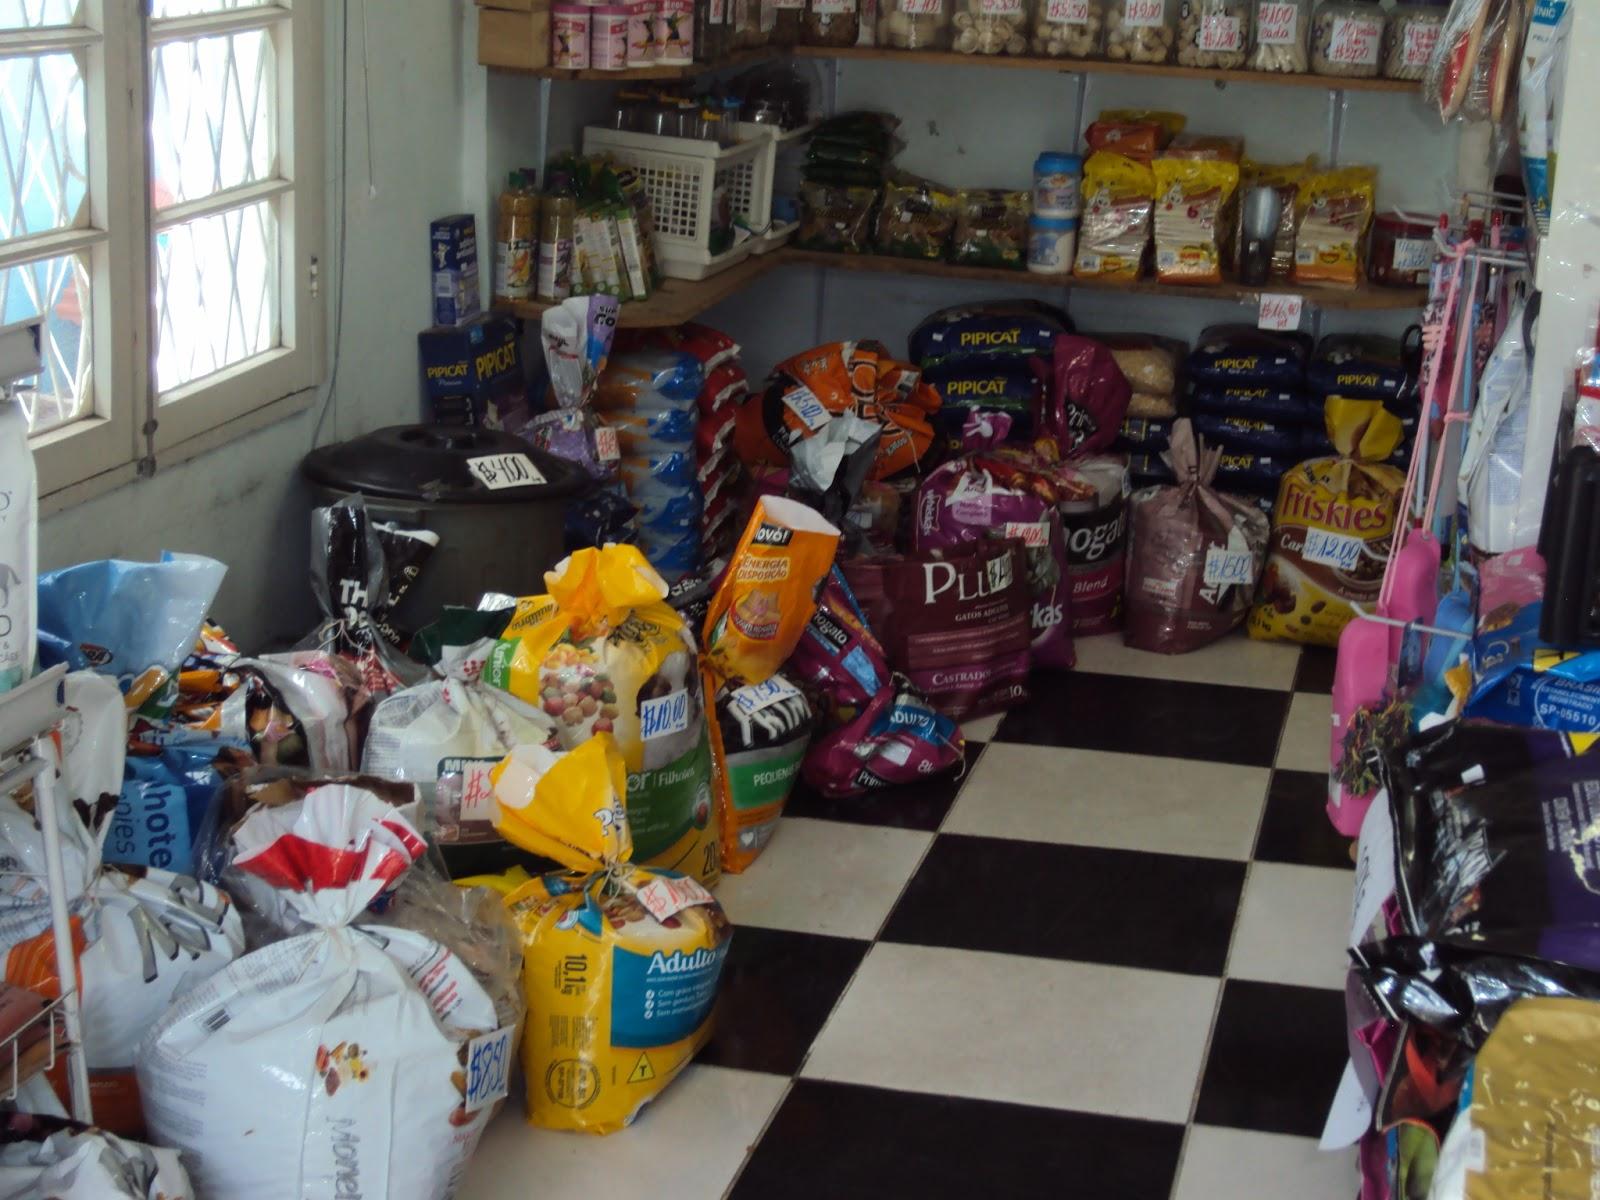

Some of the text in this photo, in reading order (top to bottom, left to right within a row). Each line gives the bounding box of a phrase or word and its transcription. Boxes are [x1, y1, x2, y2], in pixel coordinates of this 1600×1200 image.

[961, 328, 1021, 346] PIPICAT
[427, 361, 469, 379] PIPICAT
[475, 341, 516, 381] PIPICAT
[1214, 356, 1258, 370] PIPICAT
[946, 377, 1008, 396] PIPICAT
[1336, 373, 1380, 388] PIPICAT
[1282, 482, 1388, 533] Friskies
[1072, 575, 1109, 594] Blend
[645, 949, 717, 976] Adulto
